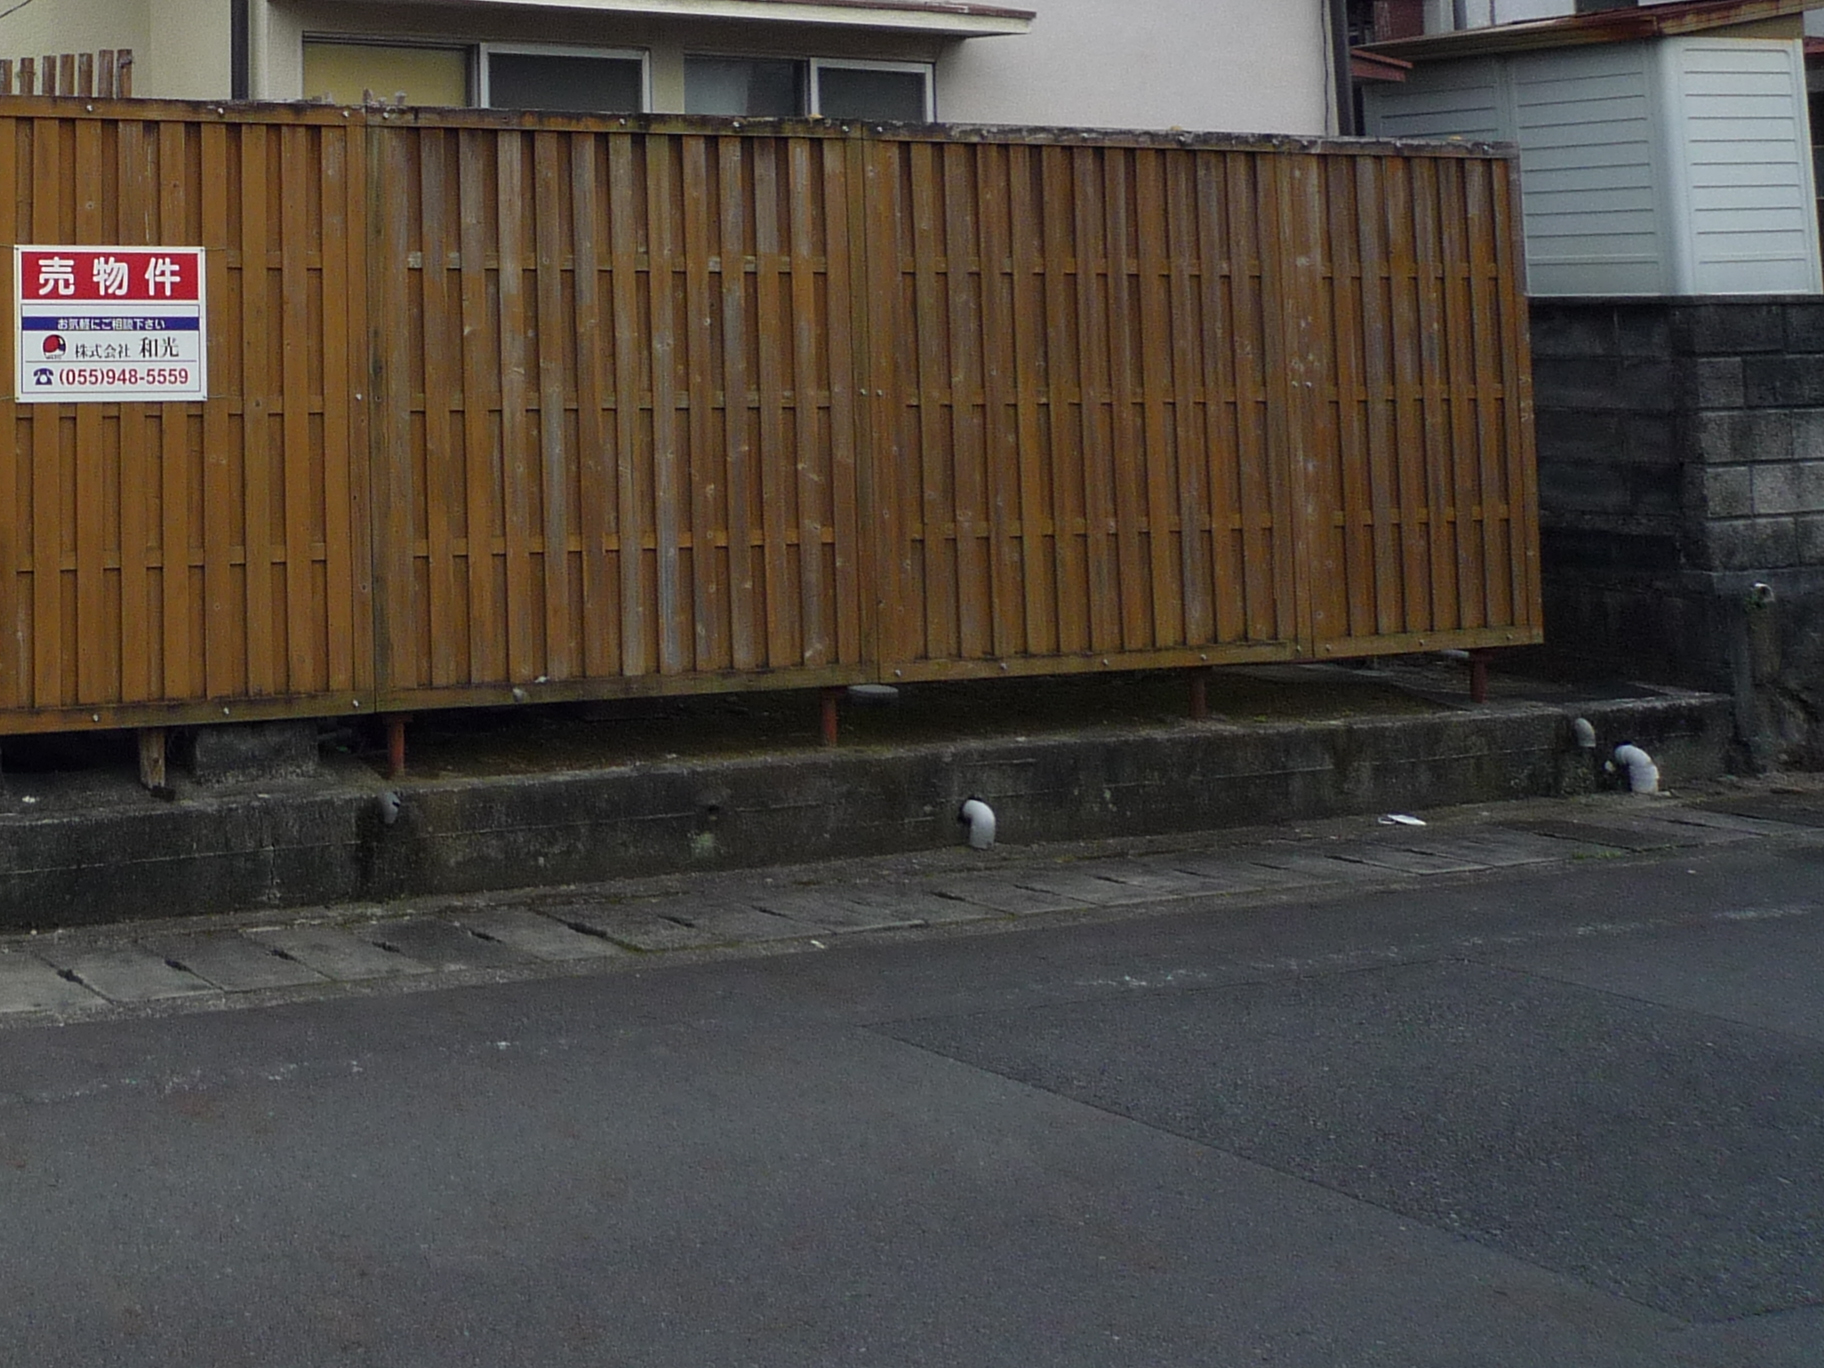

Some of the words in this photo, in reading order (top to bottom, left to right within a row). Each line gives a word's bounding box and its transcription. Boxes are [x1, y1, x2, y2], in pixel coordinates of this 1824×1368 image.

[38, 256, 180, 296] 売物件
[57, 318, 165, 330] お気軽にご相談下さい
[75, 343, 131, 359] 株式会社
[139, 336, 179, 358] 和光
[59, 368, 188, 385] (055)948-5559
